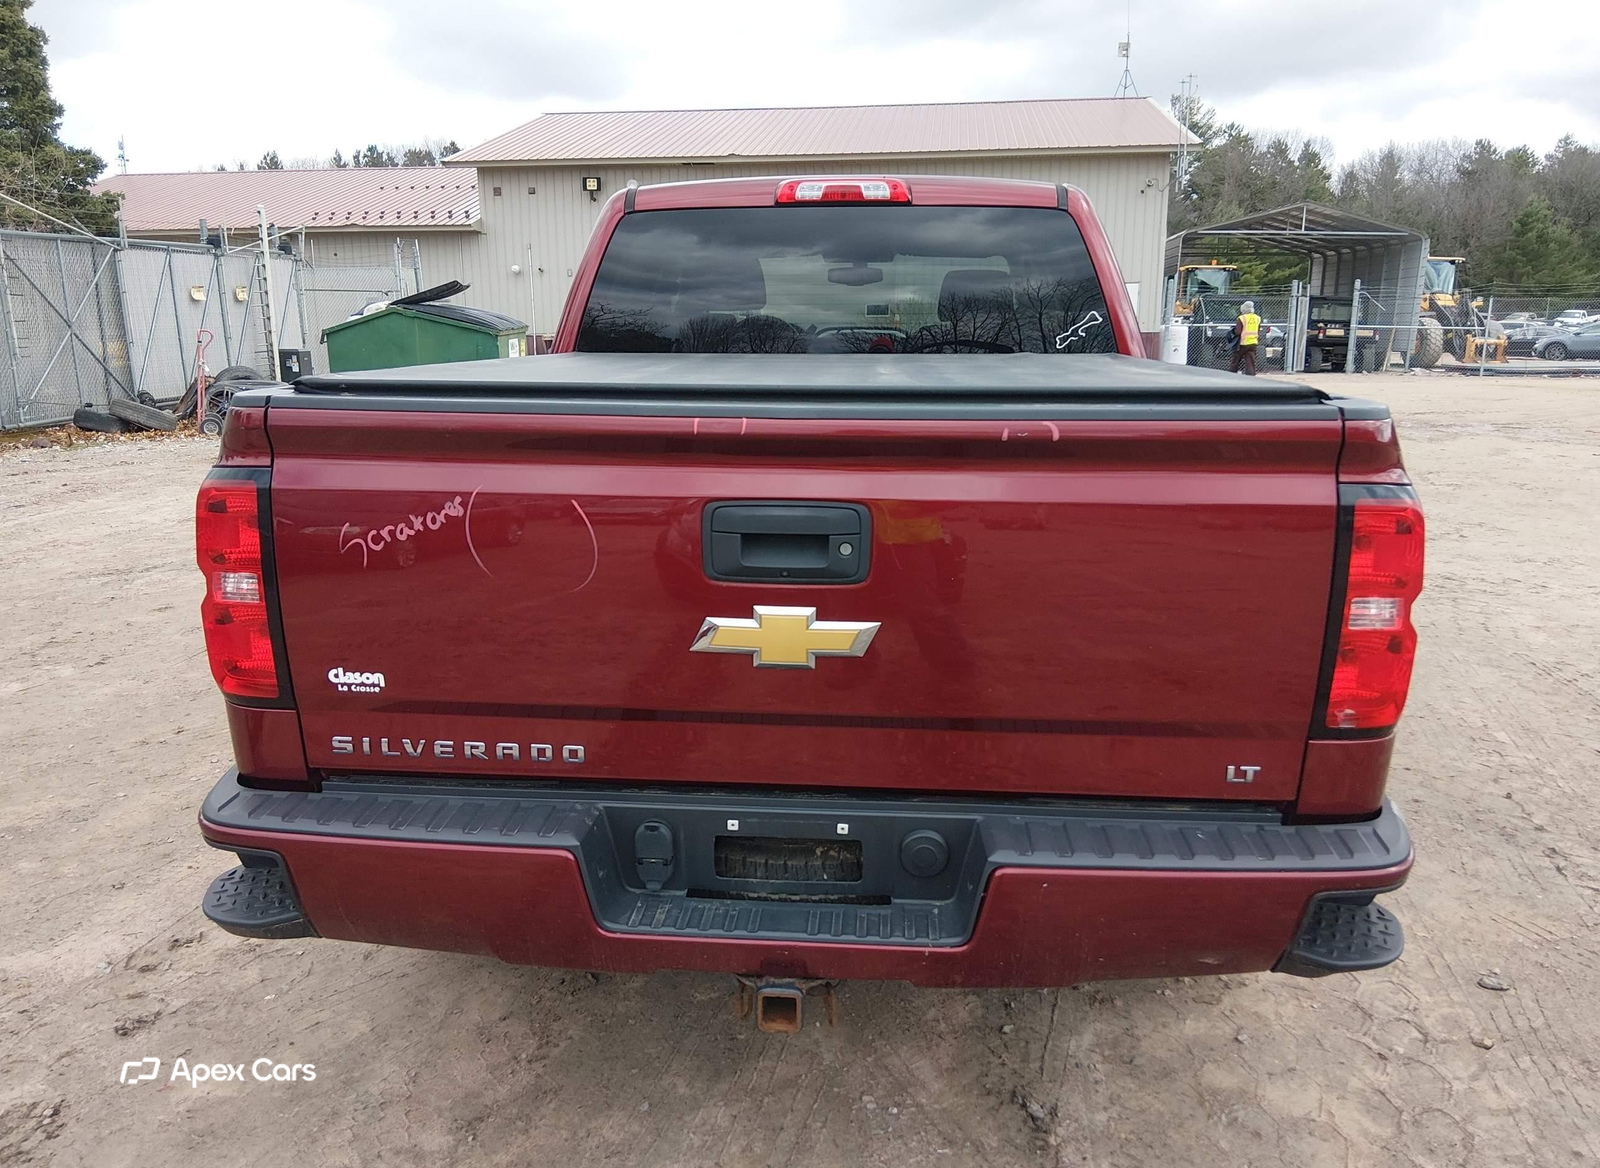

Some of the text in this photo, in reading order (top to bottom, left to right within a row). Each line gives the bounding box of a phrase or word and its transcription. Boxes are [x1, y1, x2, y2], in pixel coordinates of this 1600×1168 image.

[328, 667, 385, 687] Clason
[351, 684, 380, 692] Crosse
[331, 736, 586, 764] SILVERADO
[1226, 765, 1262, 782] LT
